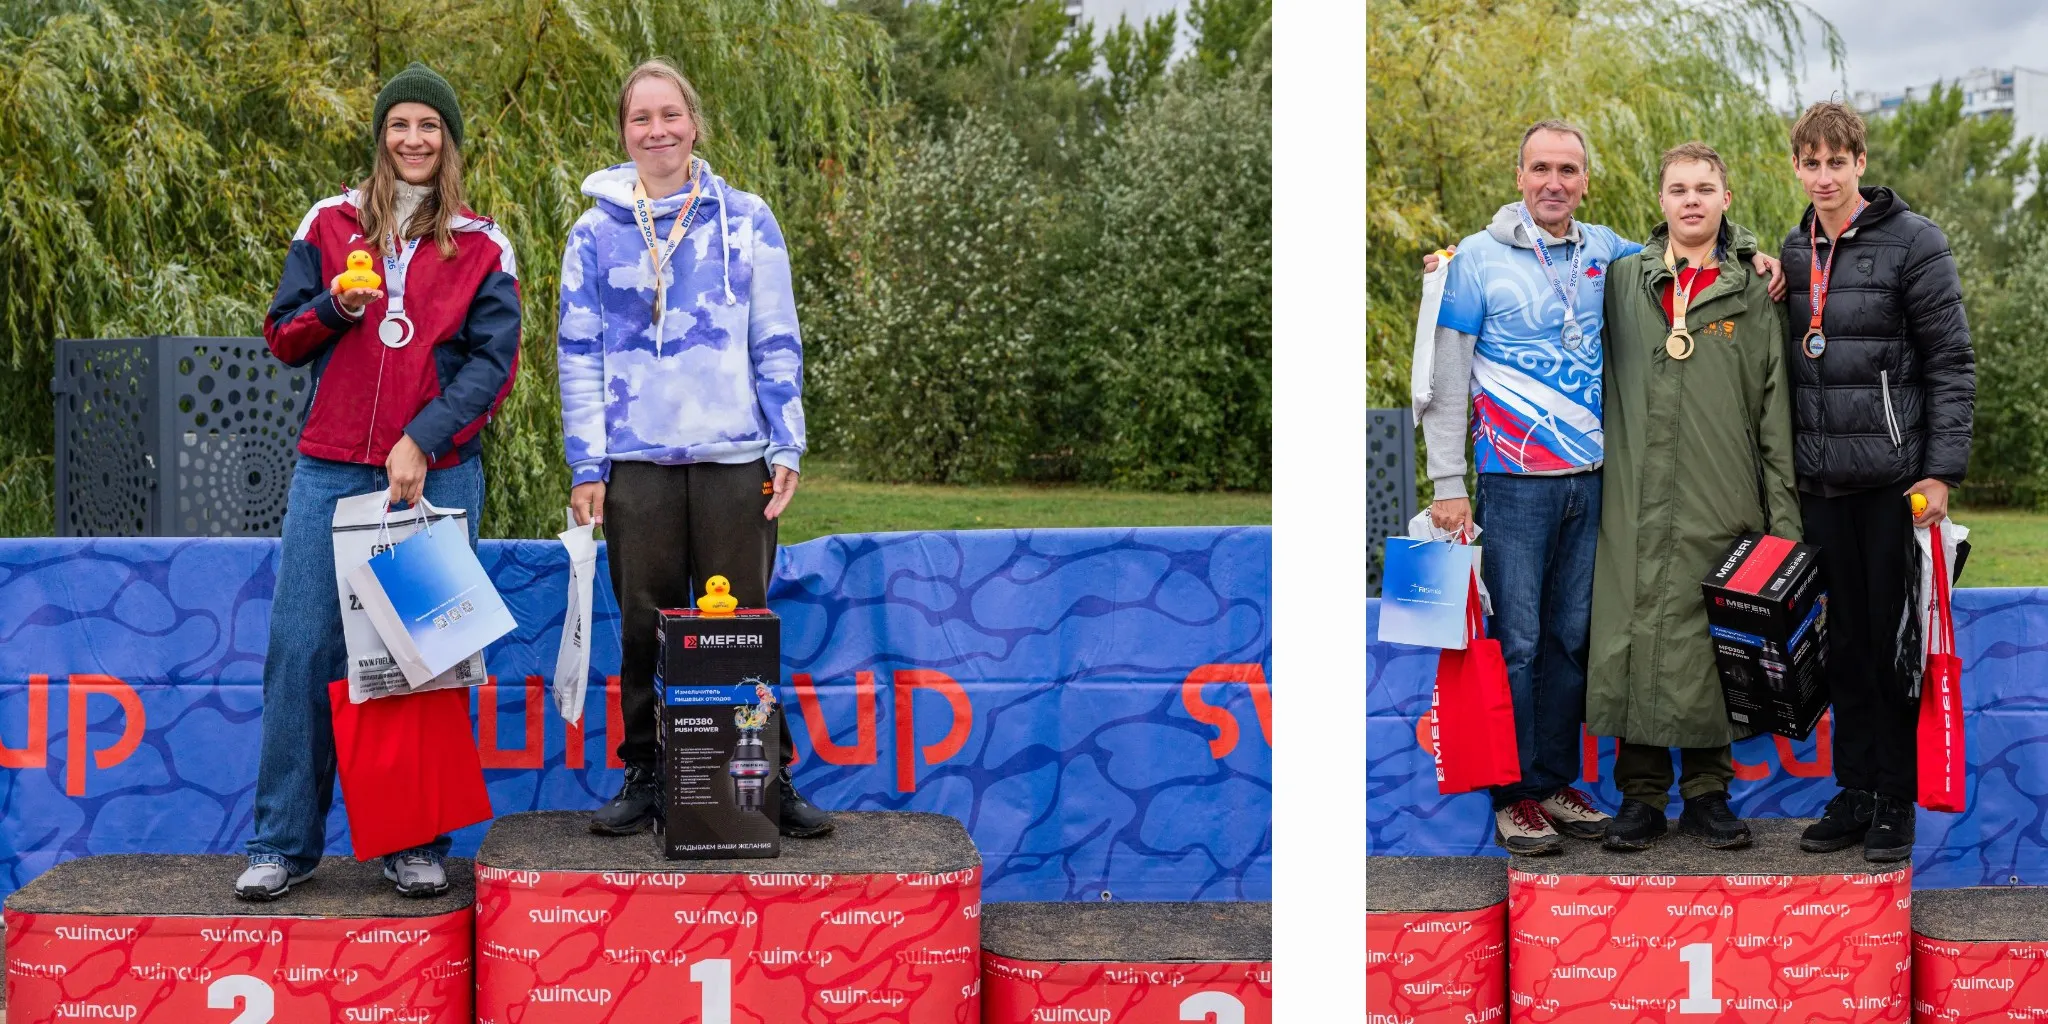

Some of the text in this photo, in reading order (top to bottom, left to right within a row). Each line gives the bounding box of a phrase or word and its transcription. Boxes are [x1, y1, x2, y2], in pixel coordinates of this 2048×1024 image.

[1715, 539, 1753, 578] MEFERI
[1725, 599, 1771, 615] MEFERI
[700, 635, 763, 645] MEFERI
[674, 718, 713, 726] MFD380
[529, 906, 612, 925] swimcup
[674, 907, 758, 928] swimcup
[820, 908, 905, 927] swimcup
[1550, 903, 1617, 918] swimcup
[1667, 903, 1733, 919] swimcup
[1783, 903, 1851, 918] swimcup
[55, 924, 139, 943] swimcup
[200, 926, 283, 945] swimcup
[346, 928, 431, 945] swimcup
[1404, 921, 1472, 935] swimcup
[1611, 934, 1677, 950] swimcup
[1726, 933, 1793, 949] swimcup
[605, 946, 686, 966] swimcup
[749, 947, 832, 967] swimcup
[130, 962, 212, 983] swimcup
[273, 963, 358, 985] swimcup
[1104, 967, 1184, 987] swimcup
[1550, 965, 1617, 982] swimcup
[1680, 943, 1722, 1015] 1
[1783, 964, 1850, 980] swimcup
[690, 958, 731, 1024] 1
[1404, 980, 1472, 997] swimcup
[1951, 976, 2014, 992] swimcup
[528, 985, 611, 1006] swimcup
[820, 986, 903, 1007] swimcup
[1609, 996, 1677, 1011] swimcup
[1726, 996, 1793, 1012] swimcup
[1843, 992, 1902, 1010] swimcup
[56, 1000, 137, 1019] swimcup
[1031, 1005, 1111, 1024] swimcup
